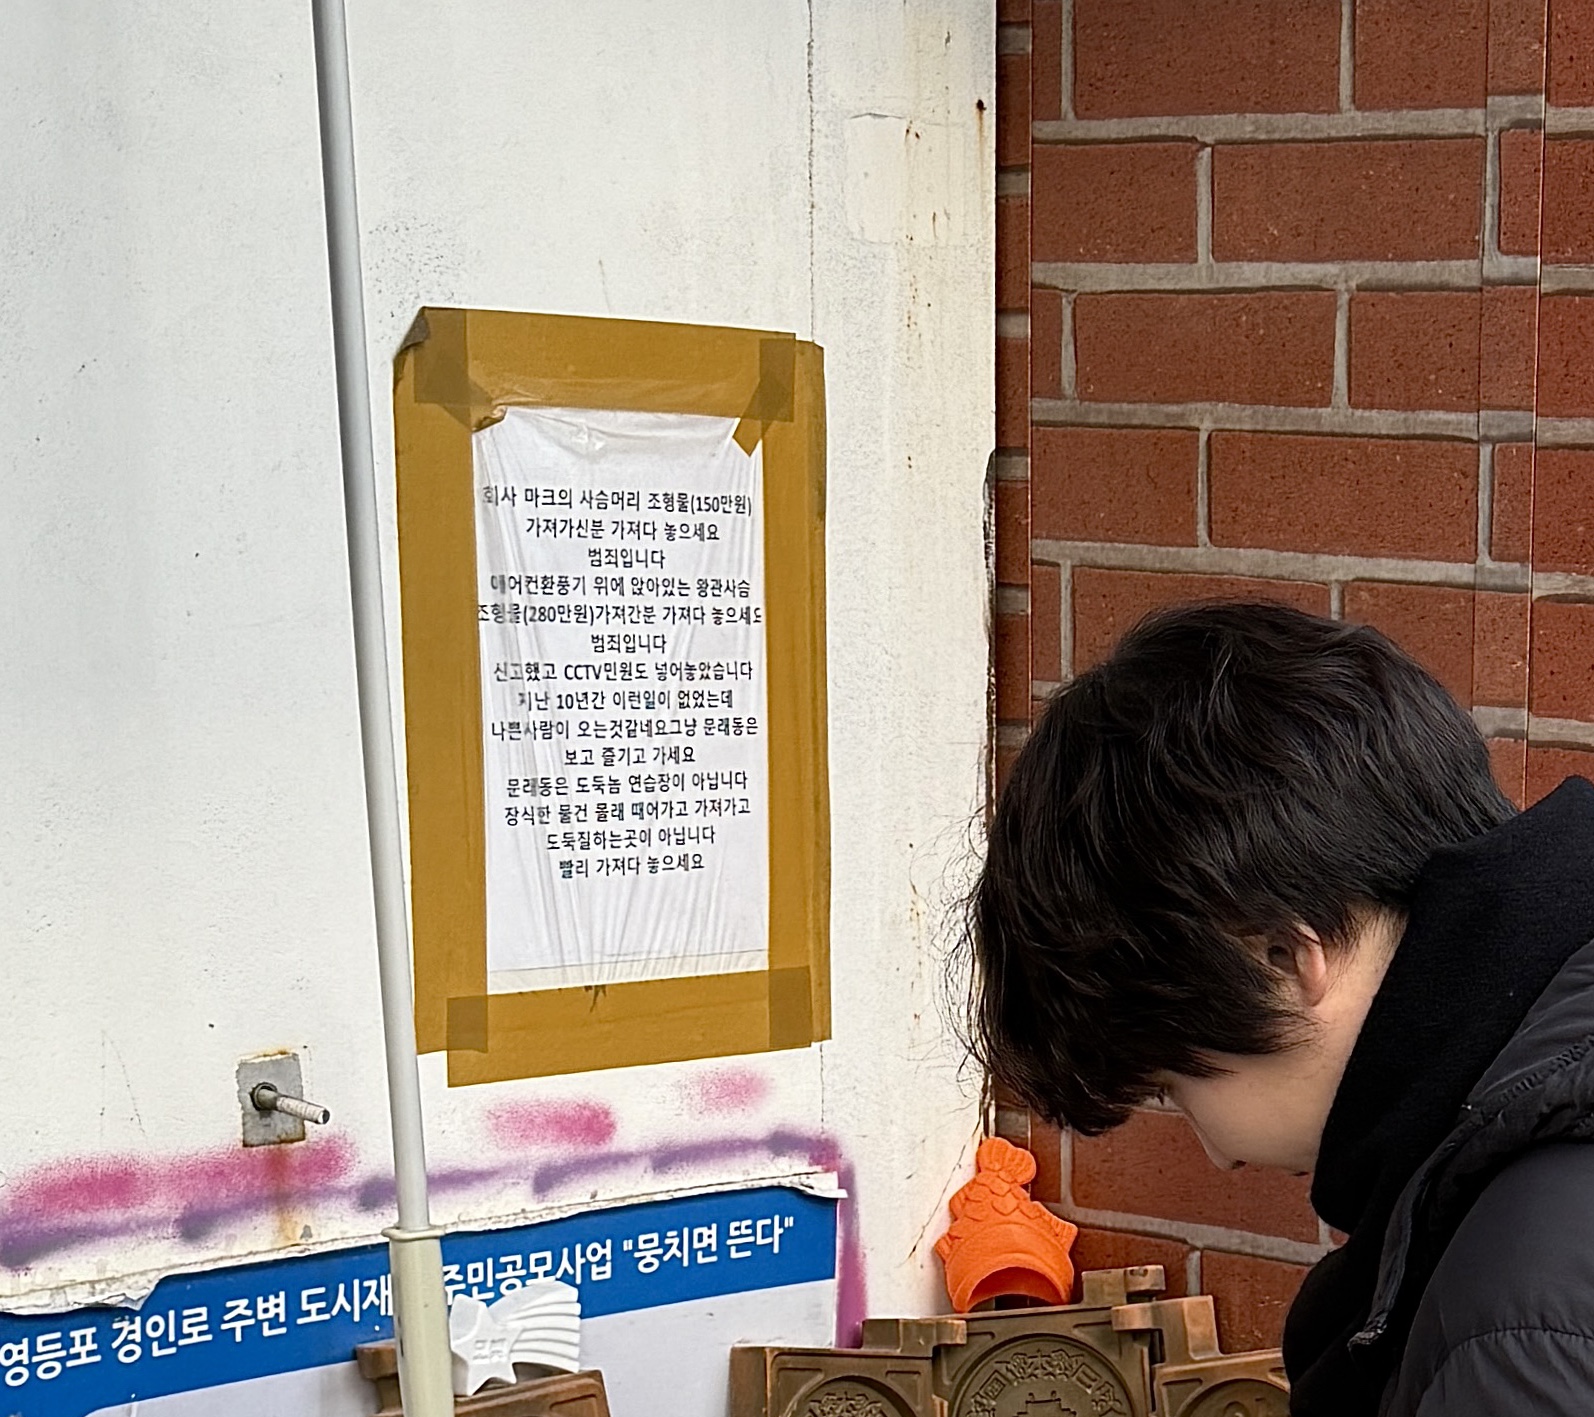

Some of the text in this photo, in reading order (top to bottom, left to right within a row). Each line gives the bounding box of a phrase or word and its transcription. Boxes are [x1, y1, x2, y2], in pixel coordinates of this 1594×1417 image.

[525, 487, 573, 509] 마크의
[580, 489, 640, 512] 사슴머리
[647, 491, 752, 516] 조형물(150만원)
[526, 517, 720, 542] 가져가신분 가져다 놓으세요
[588, 548, 666, 570] 범죄입니다
[593, 576, 624, 597] 위에
[631, 576, 691, 597] 앉아있는
[696, 578, 751, 598] 왕관사슴
[663, 605, 706, 625] 가져다
[591, 633, 667, 653] 범죄입니다
[494, 661, 753, 682] 신고했고 CCTV민원도 넣어놓았습니다
[518, 689, 733, 711] 지난 10년간 이런일이 없었는데
[491, 717, 758, 742] 나쁜사람이 오는것같네요그냥 문래동은
[564, 745, 696, 767] 보고 즐기고 가세요
[507, 770, 748, 798] 문래동은 도둑놈 연습장이 아닙니다
[505, 805, 551, 826] 장식한
[558, 803, 588, 824] 물건
[694, 797, 751, 818] 가져가고
[546, 825, 716, 851] 도둑질하는곳이 아닙니다
[559, 853, 705, 879] 빨리 가져다 놓으세요
[0, 1326, 102, 1387] 영등포
[111, 1306, 214, 1364] 경인로
[220, 1294, 288, 1343] 주변
[296, 1278, 393, 1327] 도시재
[623, 1225, 718, 1275] "뭉치면
[726, 1213, 795, 1258] 뜬다"
